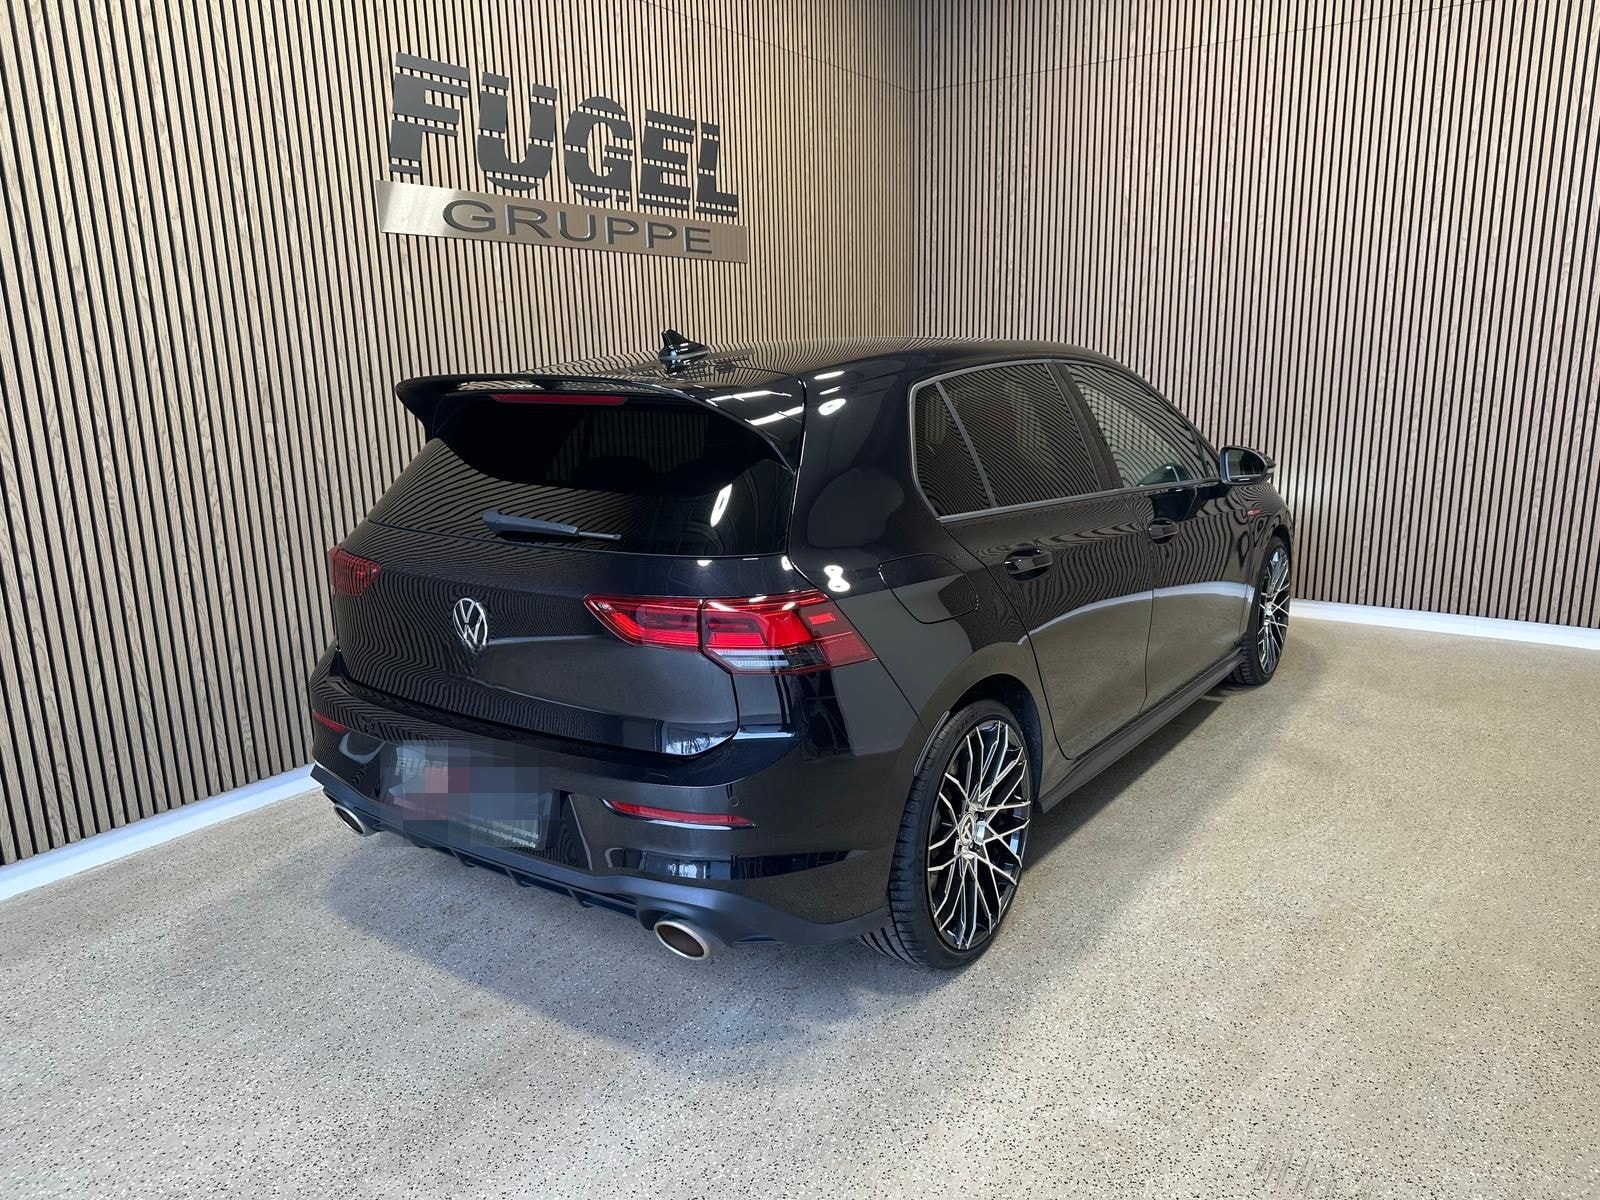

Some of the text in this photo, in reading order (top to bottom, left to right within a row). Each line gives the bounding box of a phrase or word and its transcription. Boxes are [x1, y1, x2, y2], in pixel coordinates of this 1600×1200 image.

[389, 52, 738, 217] FUGEL
[442, 198, 713, 255] GRUPPE
[453, 597, 488, 655] VW
